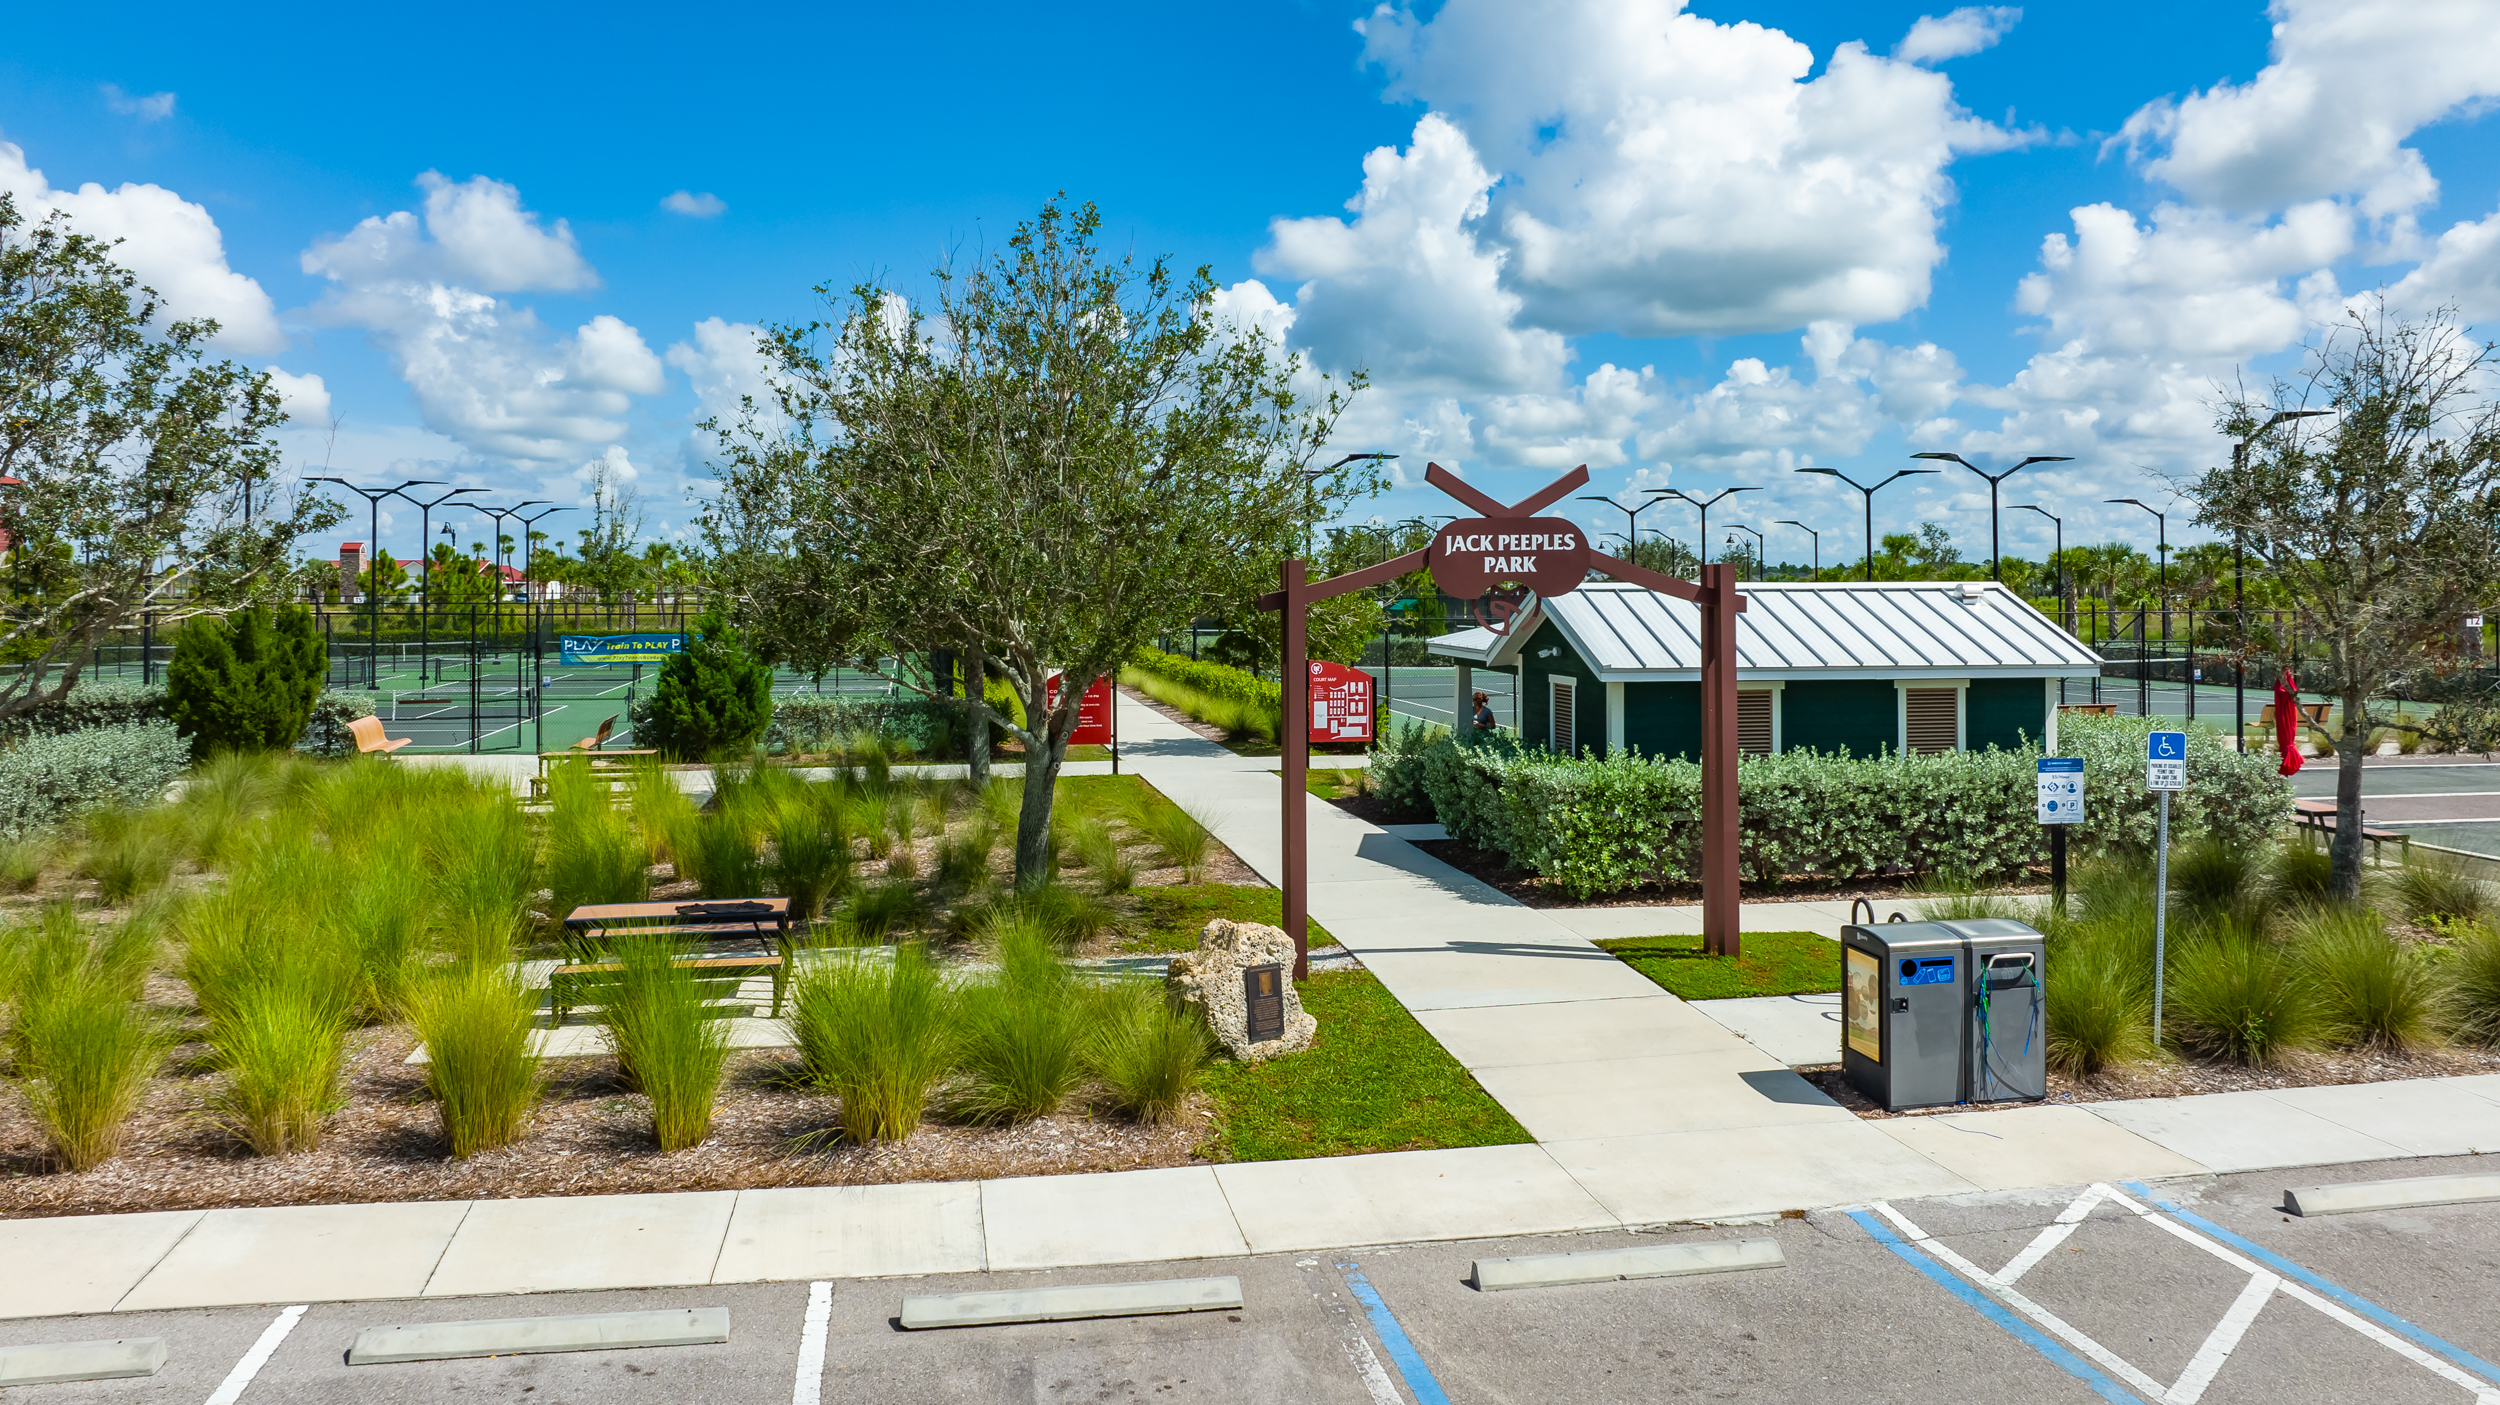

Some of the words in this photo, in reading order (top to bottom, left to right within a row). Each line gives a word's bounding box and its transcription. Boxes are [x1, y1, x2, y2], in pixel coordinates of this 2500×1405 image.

[1445, 535, 1494, 556] JACK
[1498, 534, 1576, 551] PEEPLES
[1484, 556, 1537, 573] PARK
[564, 640, 604, 654] PLAY
[606, 642, 630, 650] Train
